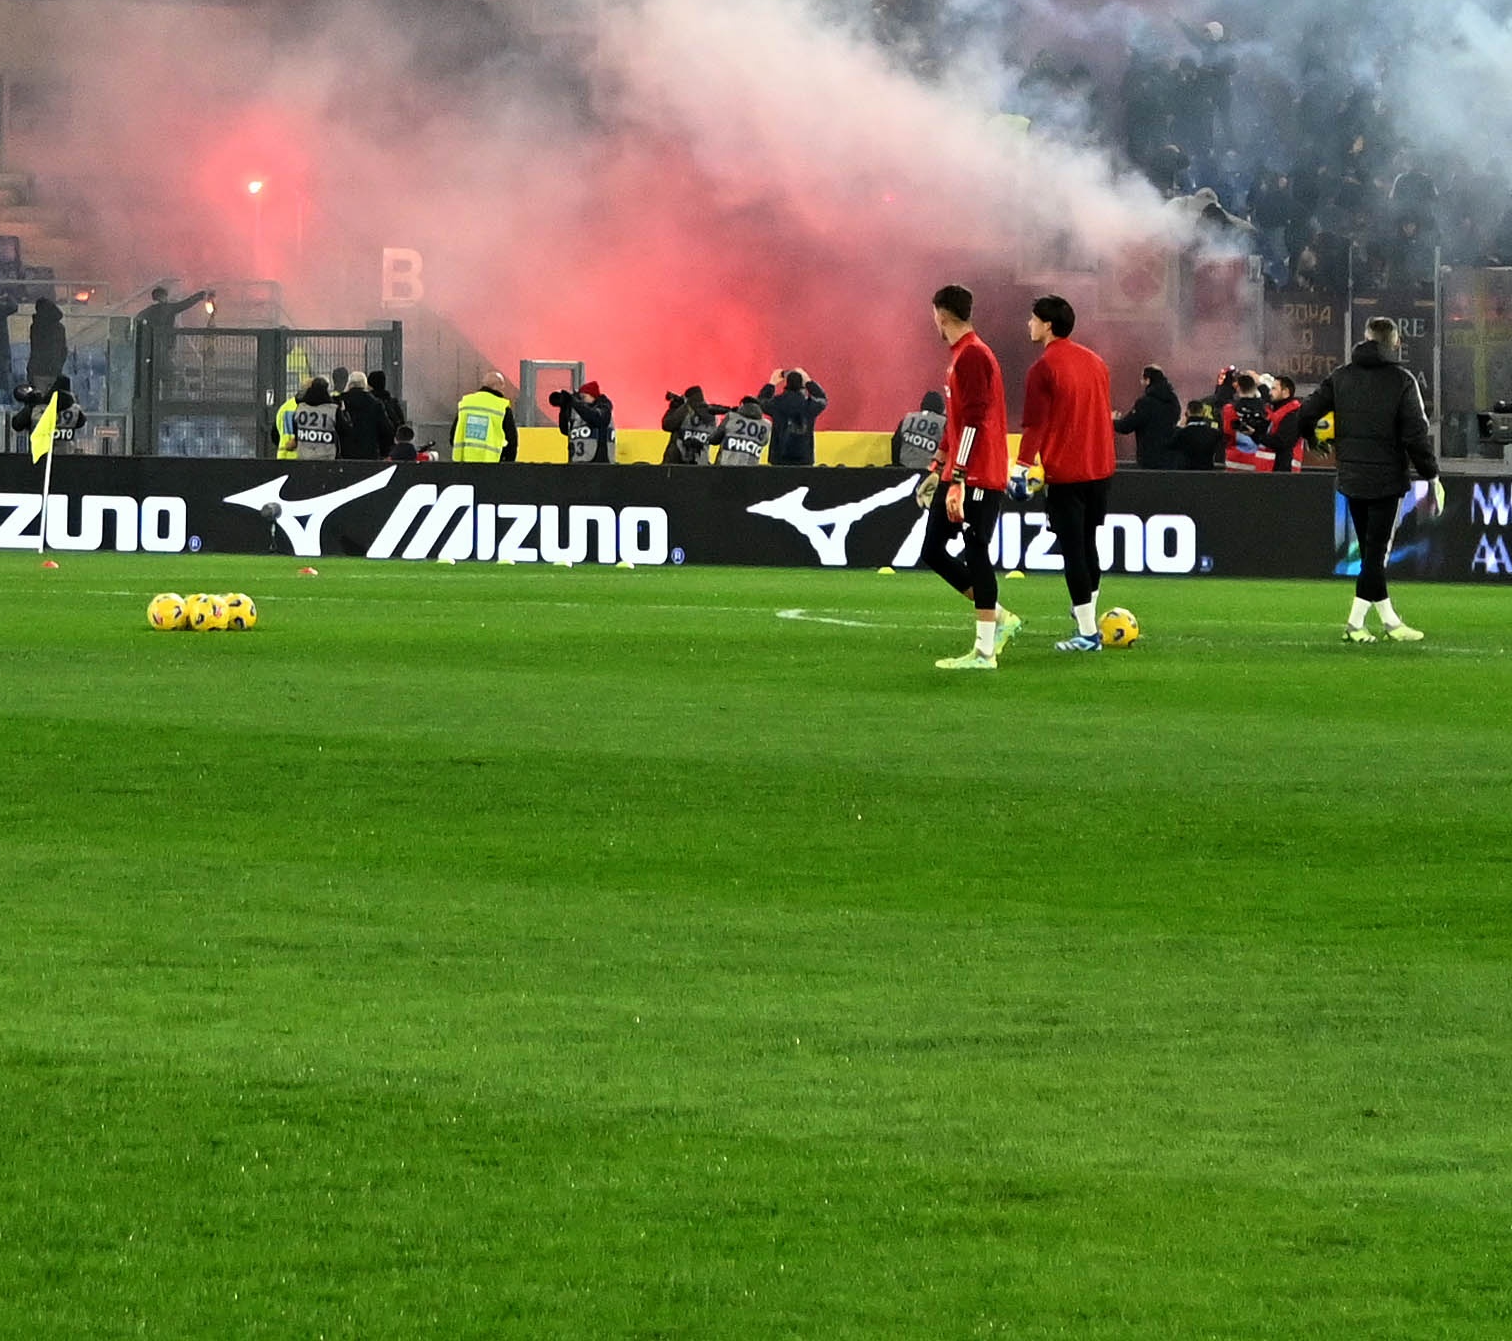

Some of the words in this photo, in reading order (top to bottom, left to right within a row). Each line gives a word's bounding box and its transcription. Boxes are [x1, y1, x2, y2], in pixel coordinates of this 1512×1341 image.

[382, 247, 425, 305] B
[298, 411, 328, 428] 021
[735, 418, 768, 439] 208
[909, 417, 939, 437] 108
[366, 483, 668, 565] MIZUNO
